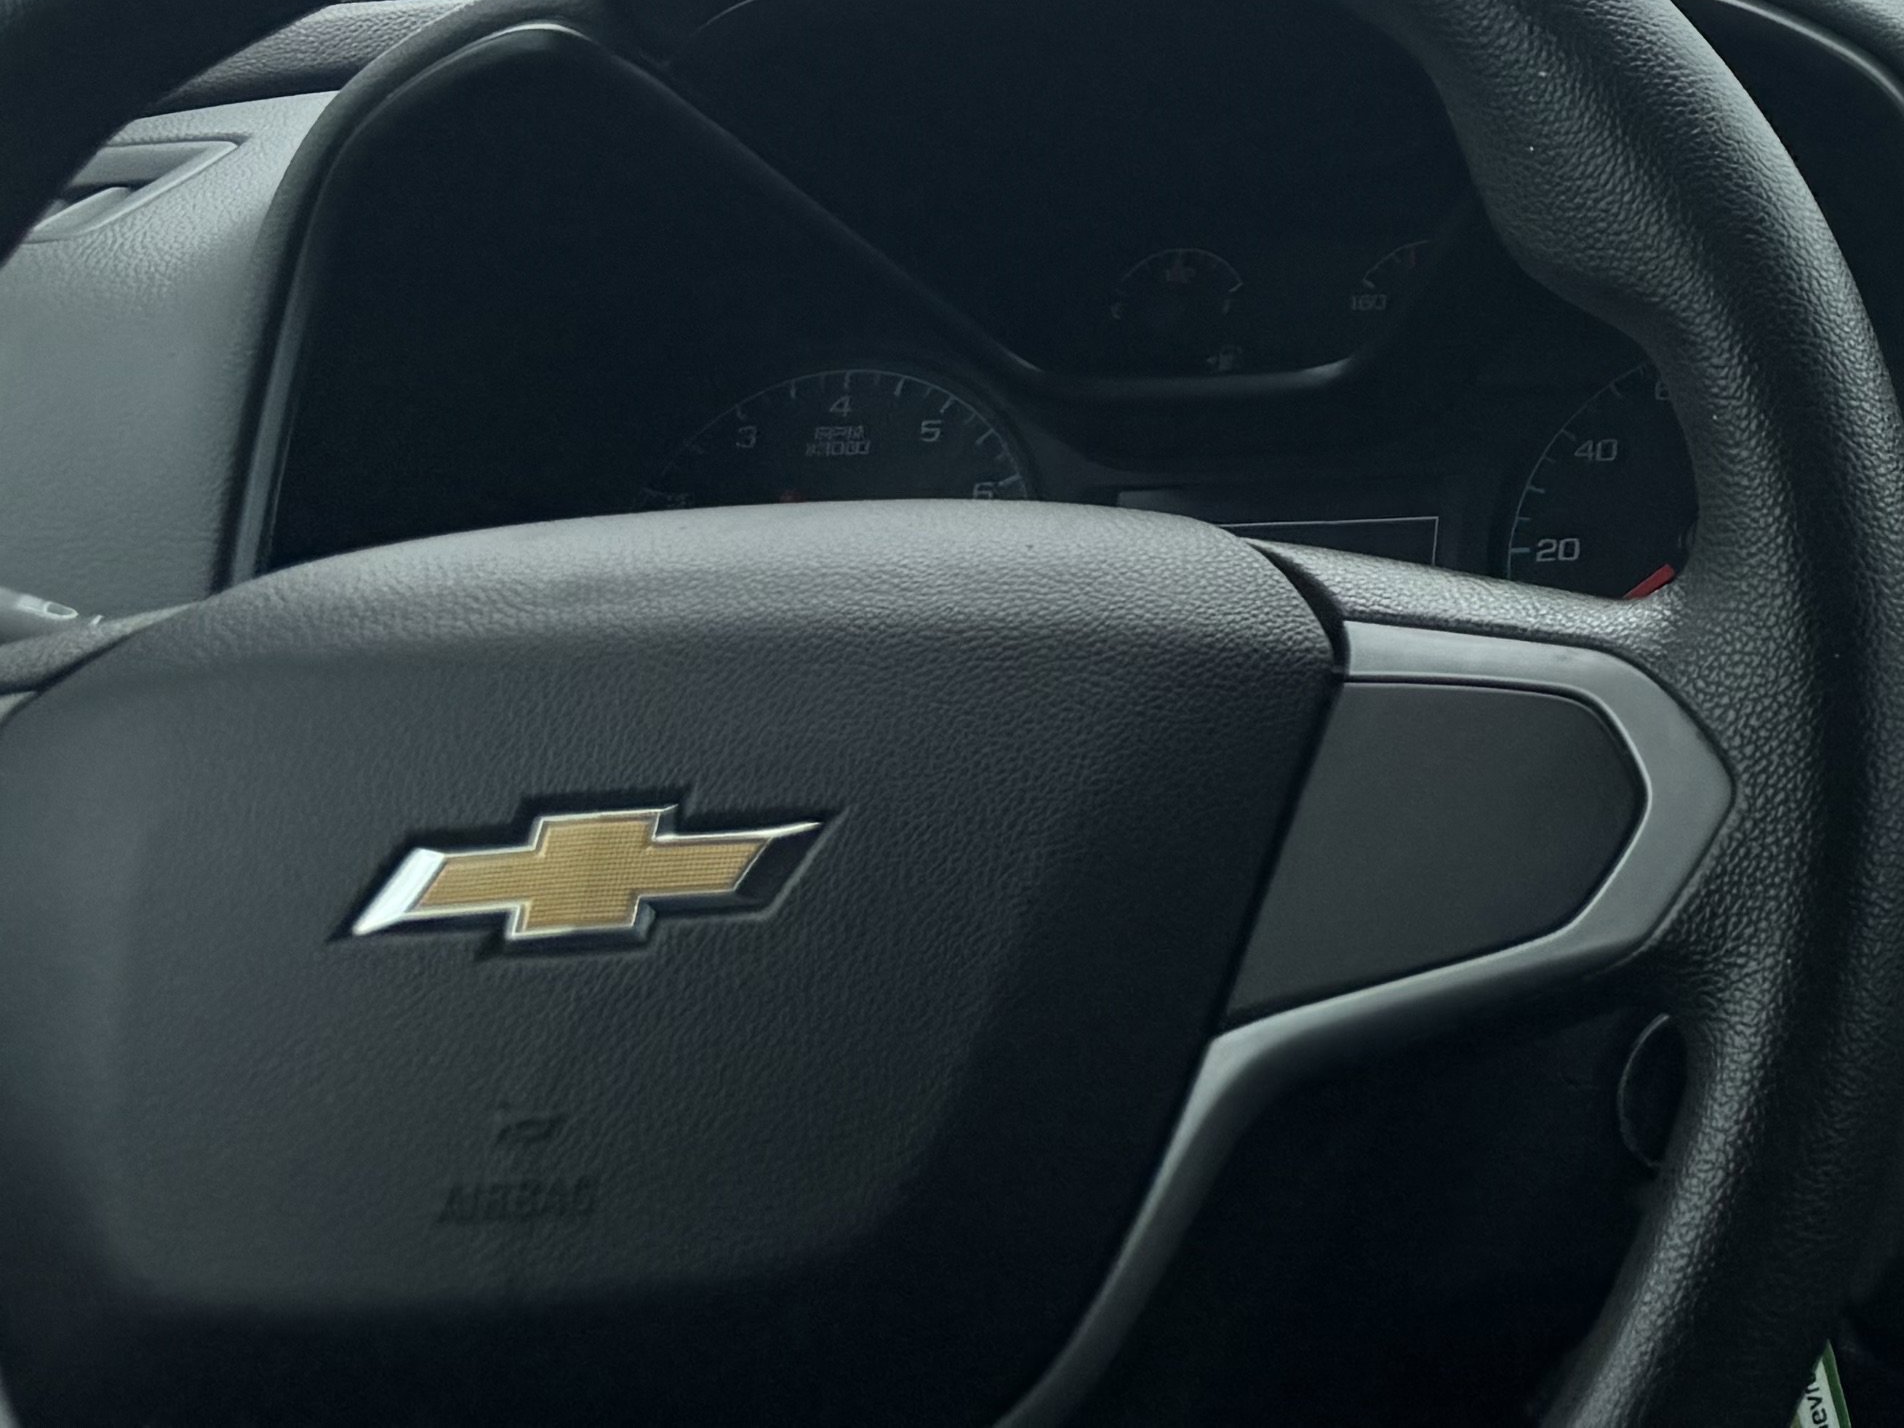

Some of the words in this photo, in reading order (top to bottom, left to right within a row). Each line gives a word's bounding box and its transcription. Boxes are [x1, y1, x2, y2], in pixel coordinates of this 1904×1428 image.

[829, 395, 852, 417] 4
[735, 424, 758, 449] 3
[919, 419, 943, 443] 5
[1573, 438, 1619, 463] 40
[1535, 537, 1581, 563] 20
